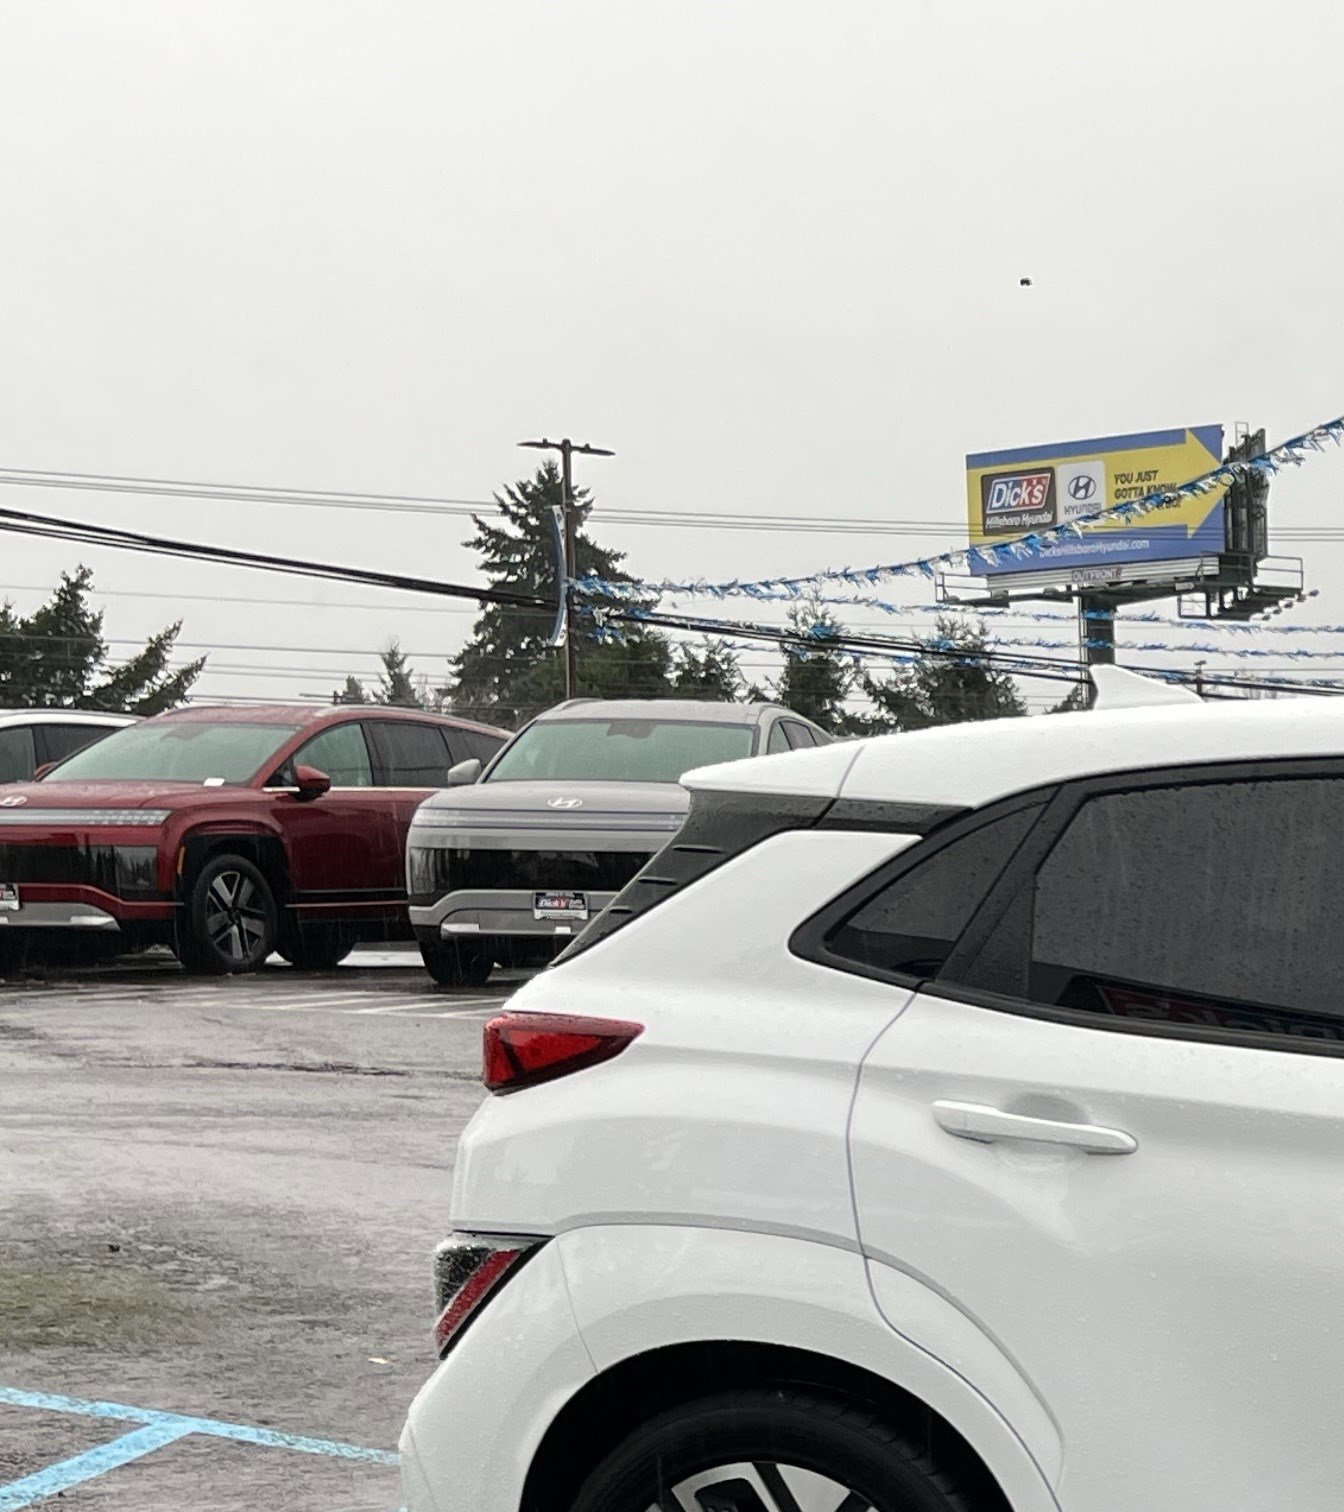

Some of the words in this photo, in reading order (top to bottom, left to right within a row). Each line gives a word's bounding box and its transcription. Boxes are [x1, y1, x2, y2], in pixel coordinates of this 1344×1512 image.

[1114, 473, 1133, 485] YOU
[1135, 470, 1159, 482] JUST
[992, 479, 1043, 508] Dick's
[1114, 486, 1145, 500] GOTTA
